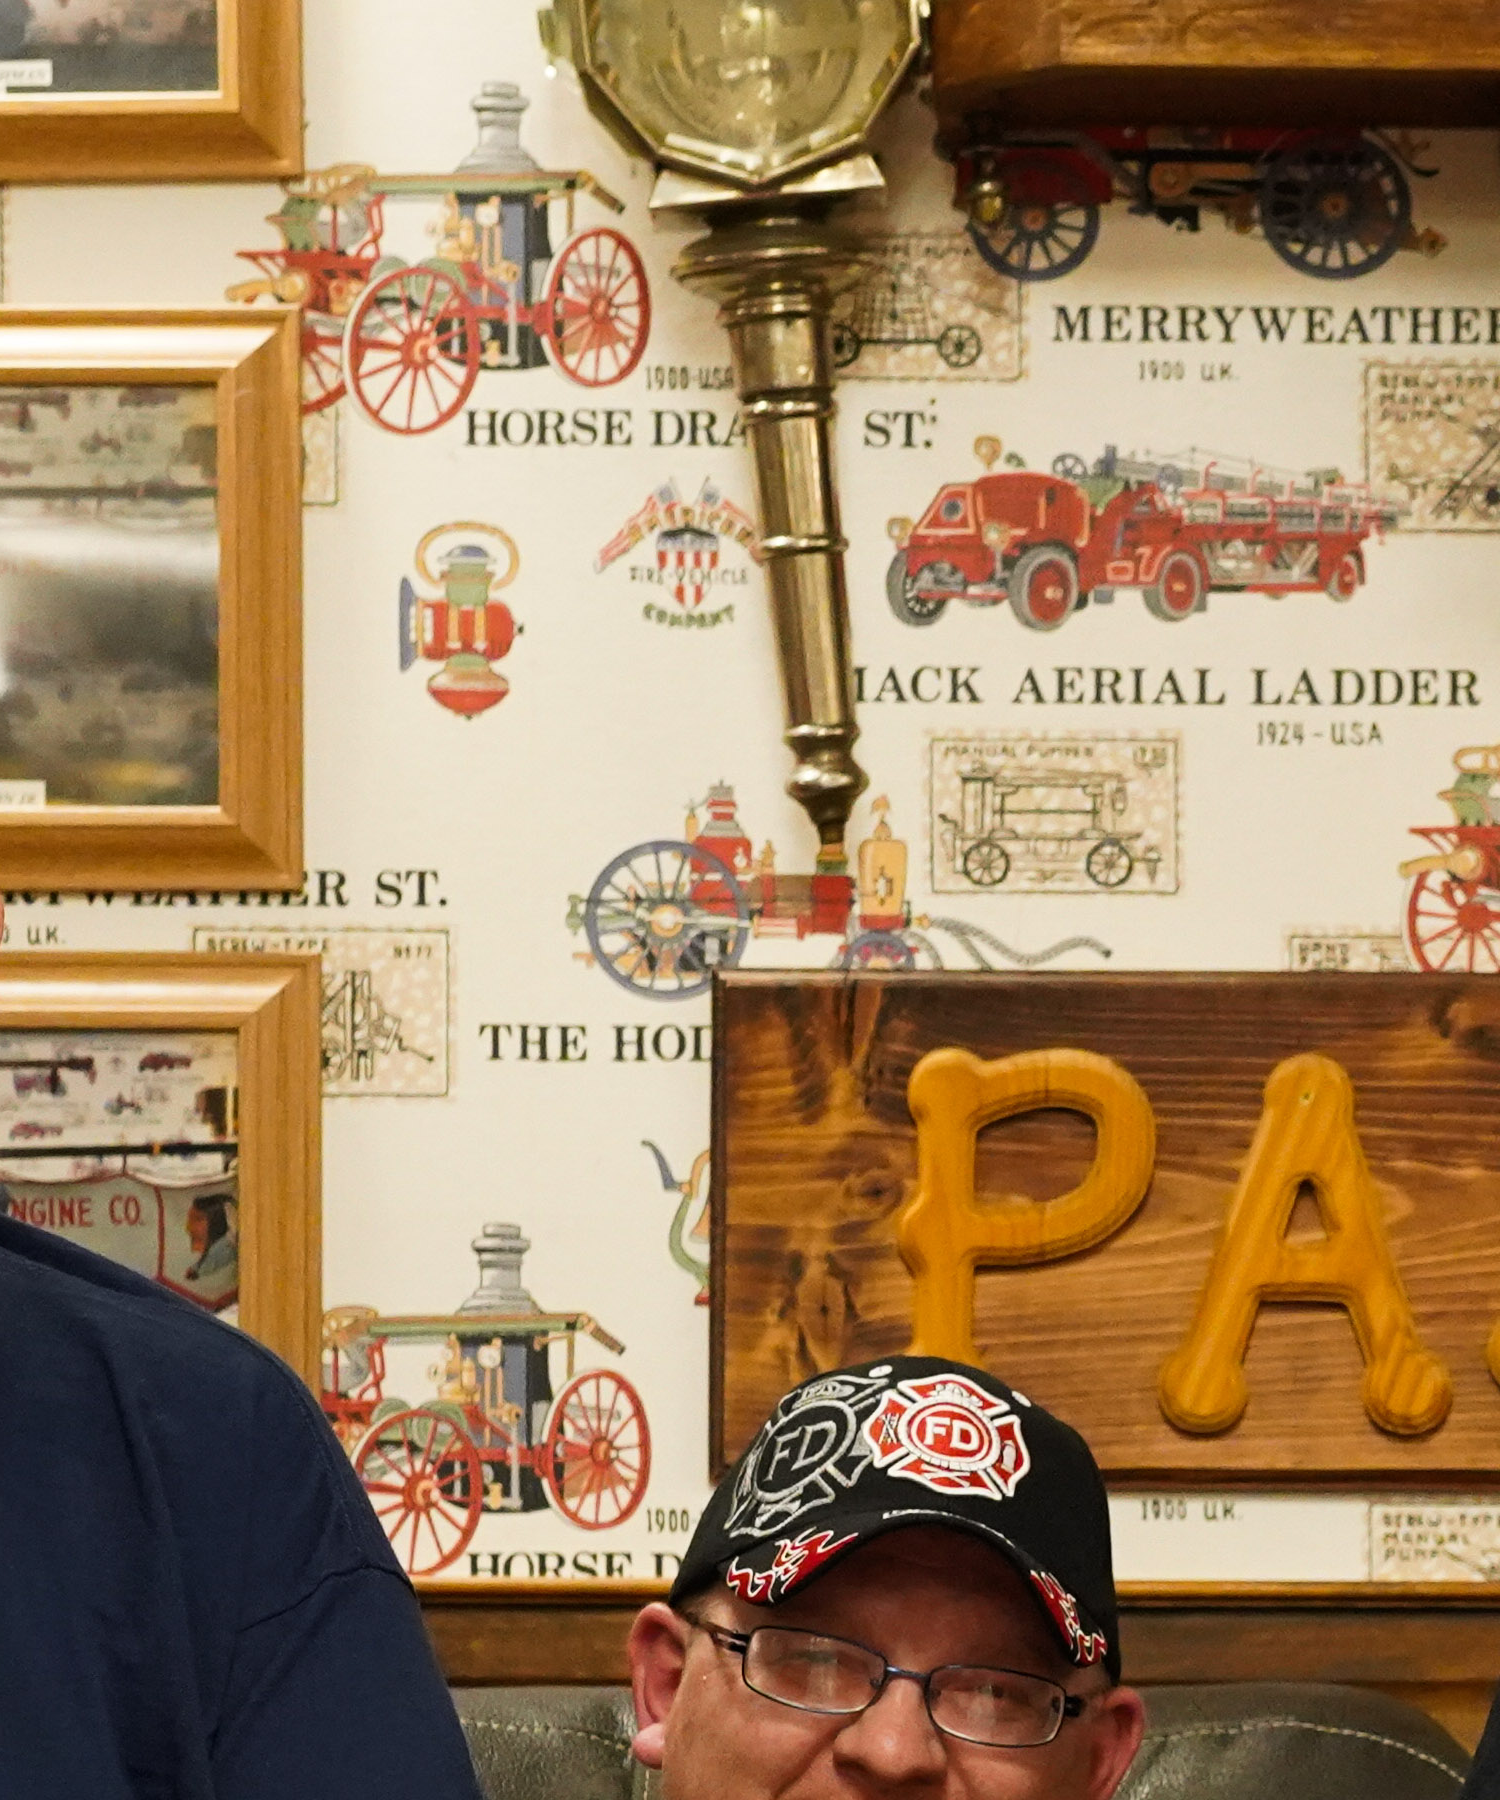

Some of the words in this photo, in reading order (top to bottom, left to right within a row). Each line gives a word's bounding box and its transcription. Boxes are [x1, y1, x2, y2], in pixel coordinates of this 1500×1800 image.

[466, 409, 632, 447] HORSE
[650, 409, 750, 447] DRA
[852, 667, 983, 704] ACK
[1012, 667, 1227, 705] AERIAL
[1250, 668, 1482, 706] LADDER
[1256, 720, 1305, 747] 1924
[1329, 720, 1383, 747] USA
[374, 870, 448, 907] ST.
[479, 1023, 588, 1063] THE
[10, 1196, 94, 1228] NGINE
[761, 1420, 838, 1482] FD
[925, 1416, 979, 1452] FD
[1141, 1499, 1188, 1521] 1900
